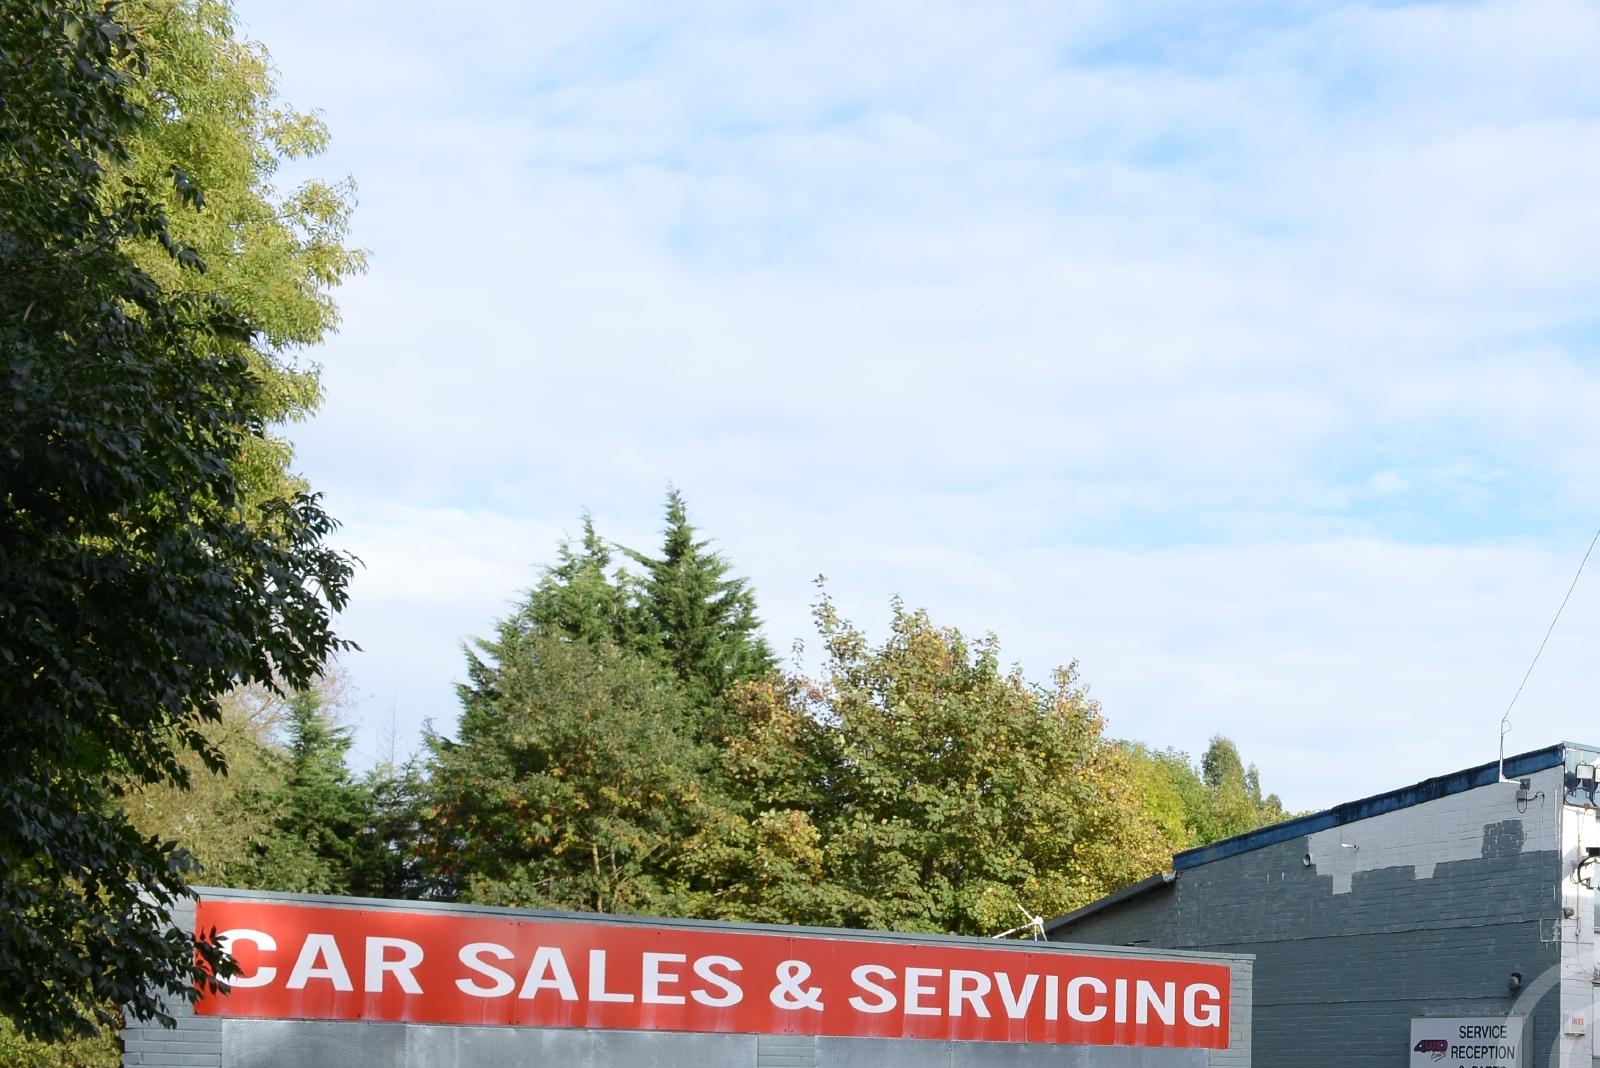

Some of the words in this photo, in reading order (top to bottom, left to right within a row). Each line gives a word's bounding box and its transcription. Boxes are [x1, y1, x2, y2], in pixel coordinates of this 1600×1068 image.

[215, 928, 424, 994] CAR
[455, 942, 744, 1008] SALES
[769, 959, 824, 1011] &
[848, 964, 1221, 1028] SERVICING
[1459, 1025, 1507, 1039] SERVICE
[1451, 1045, 1515, 1060] RECEPTION
